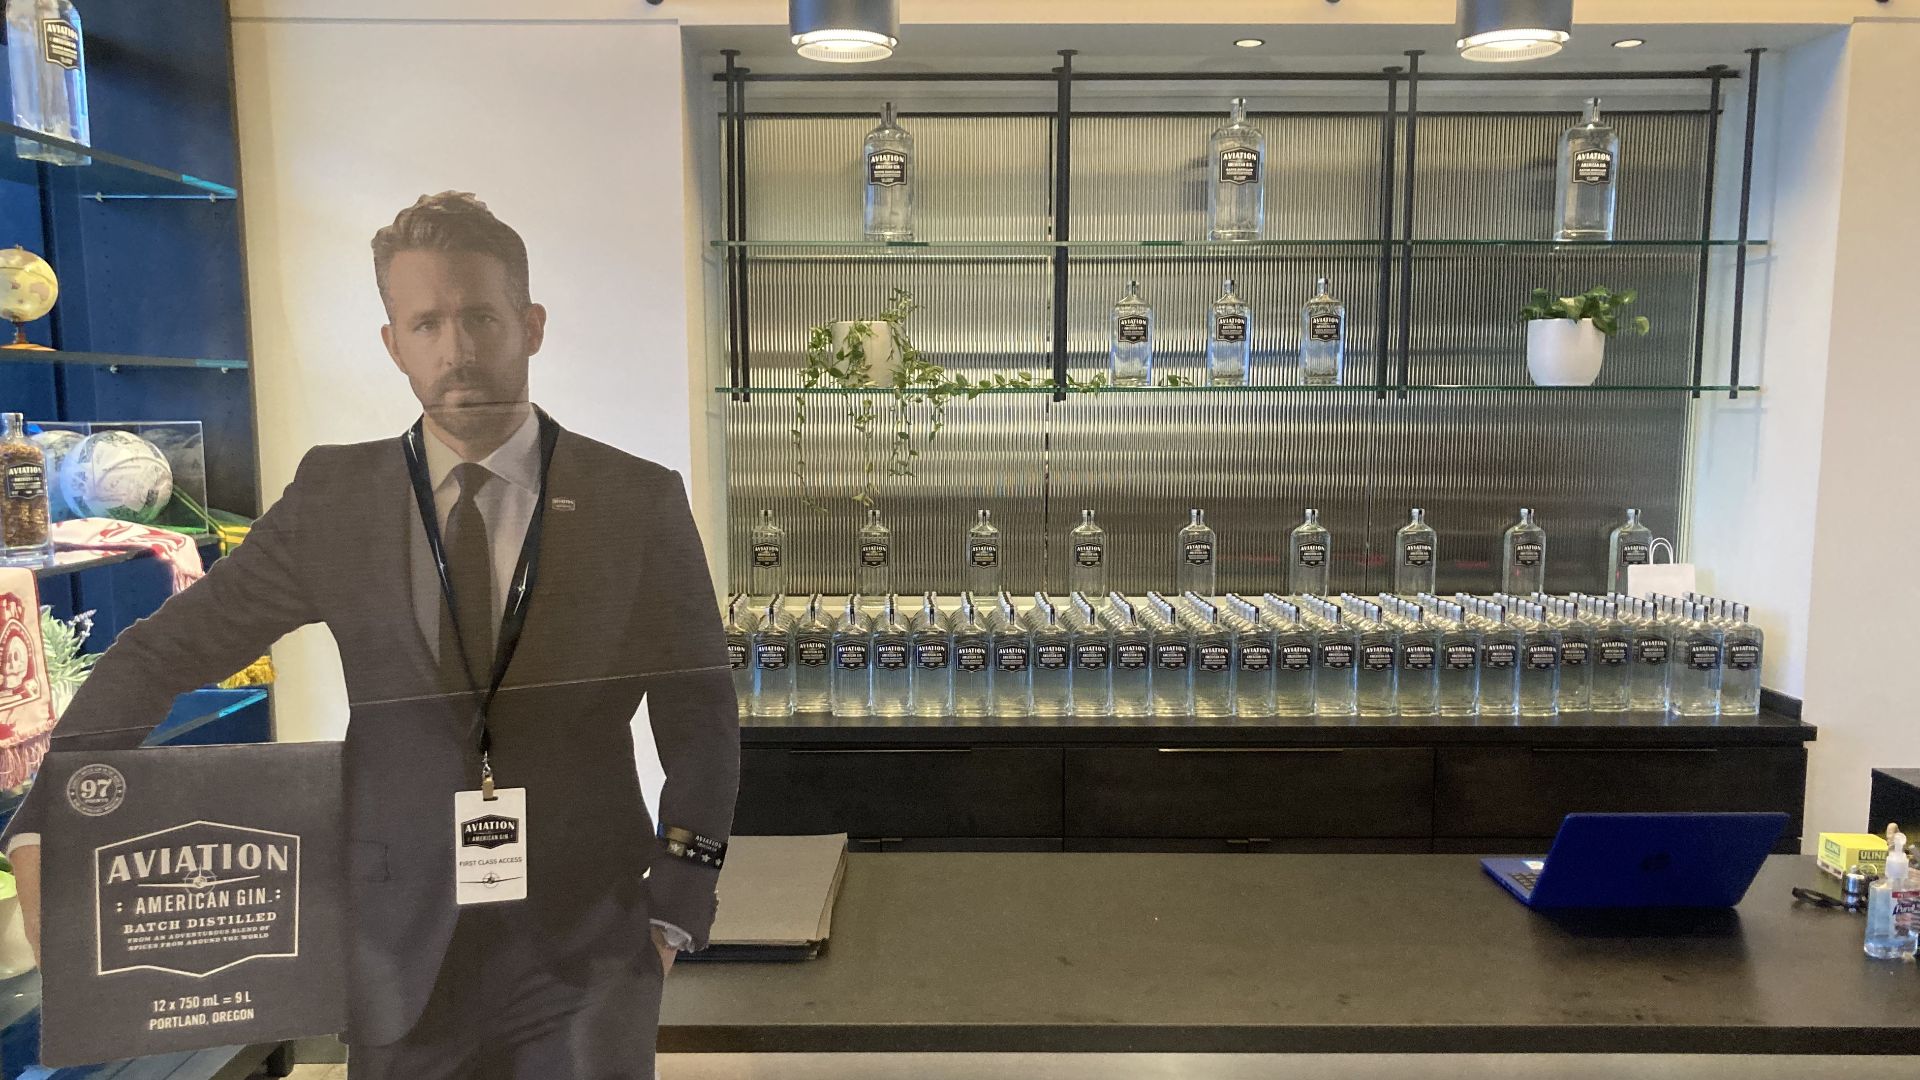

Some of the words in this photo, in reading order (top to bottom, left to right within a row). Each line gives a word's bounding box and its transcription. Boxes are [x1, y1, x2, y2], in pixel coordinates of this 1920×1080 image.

[870, 154, 904, 163] AVIATION
[1222, 152, 1257, 160] AVIATION
[1577, 152, 1610, 161] AVIATION
[80, 779, 112, 798] 97
[465, 820, 515, 833] AVIATION
[1860, 851, 1887, 860] ULINE
[107, 843, 288, 885] AVIATION
[136, 890, 230, 915] AMERICAN
[123, 920, 180, 934] BATCH
[187, 912, 277, 928] DISTILLED
[128, 936, 151, 944] FROM
[168, 929, 230, 940] ADVENTUROUS
[186, 937, 221, 946] AROUND
[241, 932, 269, 940] WORLD
[153, 999, 166, 1012] 12
[169, 1001, 176, 1011] x
[179, 996, 200, 1010] 750
[202, 994, 220, 1007] mL
[222, 996, 232, 1004] =
[235, 991, 242, 1004] 9
[245, 990, 252, 1002] L
[149, 1013, 209, 1030] PORTLAND,
[212, 1008, 254, 1023] OREGON
